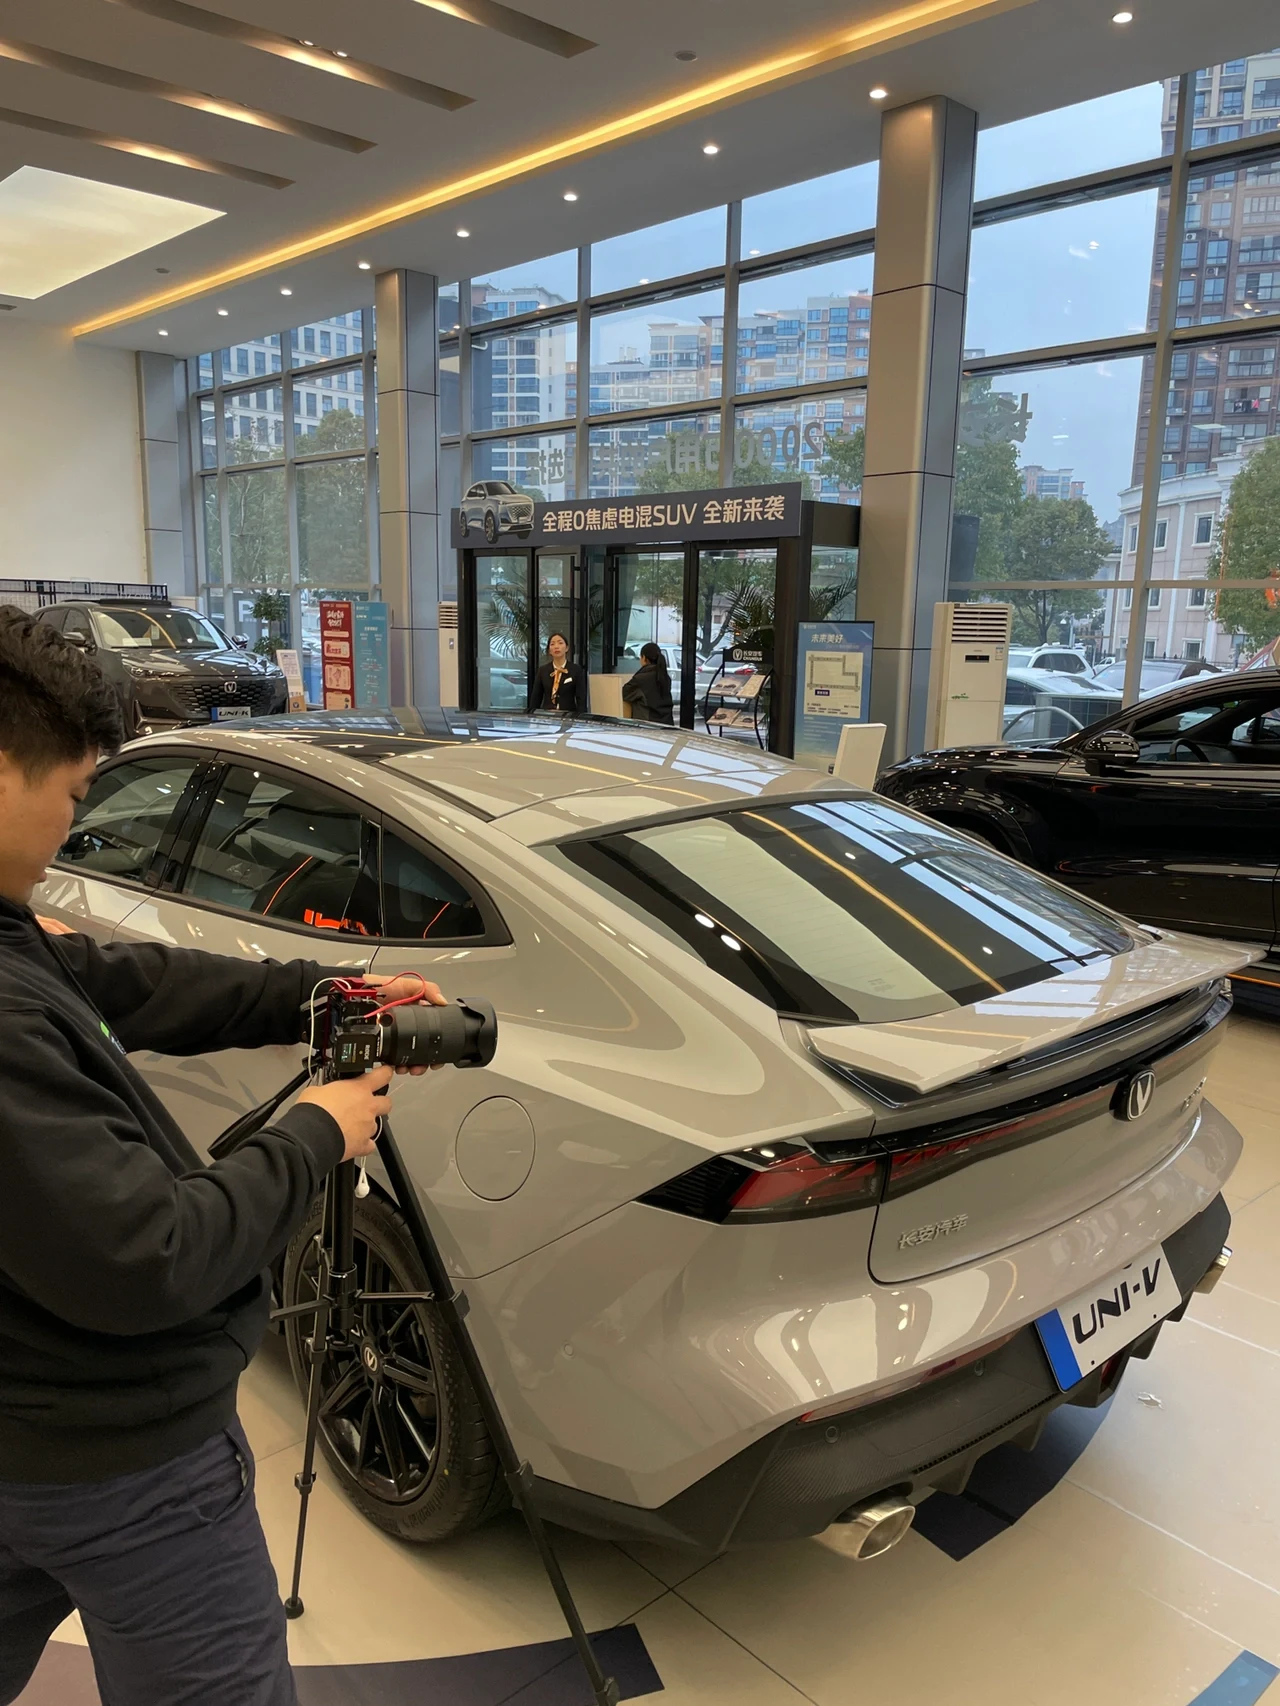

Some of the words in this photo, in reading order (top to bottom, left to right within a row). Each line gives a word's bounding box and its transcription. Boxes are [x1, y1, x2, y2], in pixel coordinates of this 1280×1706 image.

[542, 502, 698, 532] 全程0焦虑电混SUV
[702, 495, 786, 525] 全新来袭
[811, 634, 844, 643] 未来美好
[898, 1213, 969, 1250] 长安汽车
[1072, 1257, 1161, 1344] UNI-V
